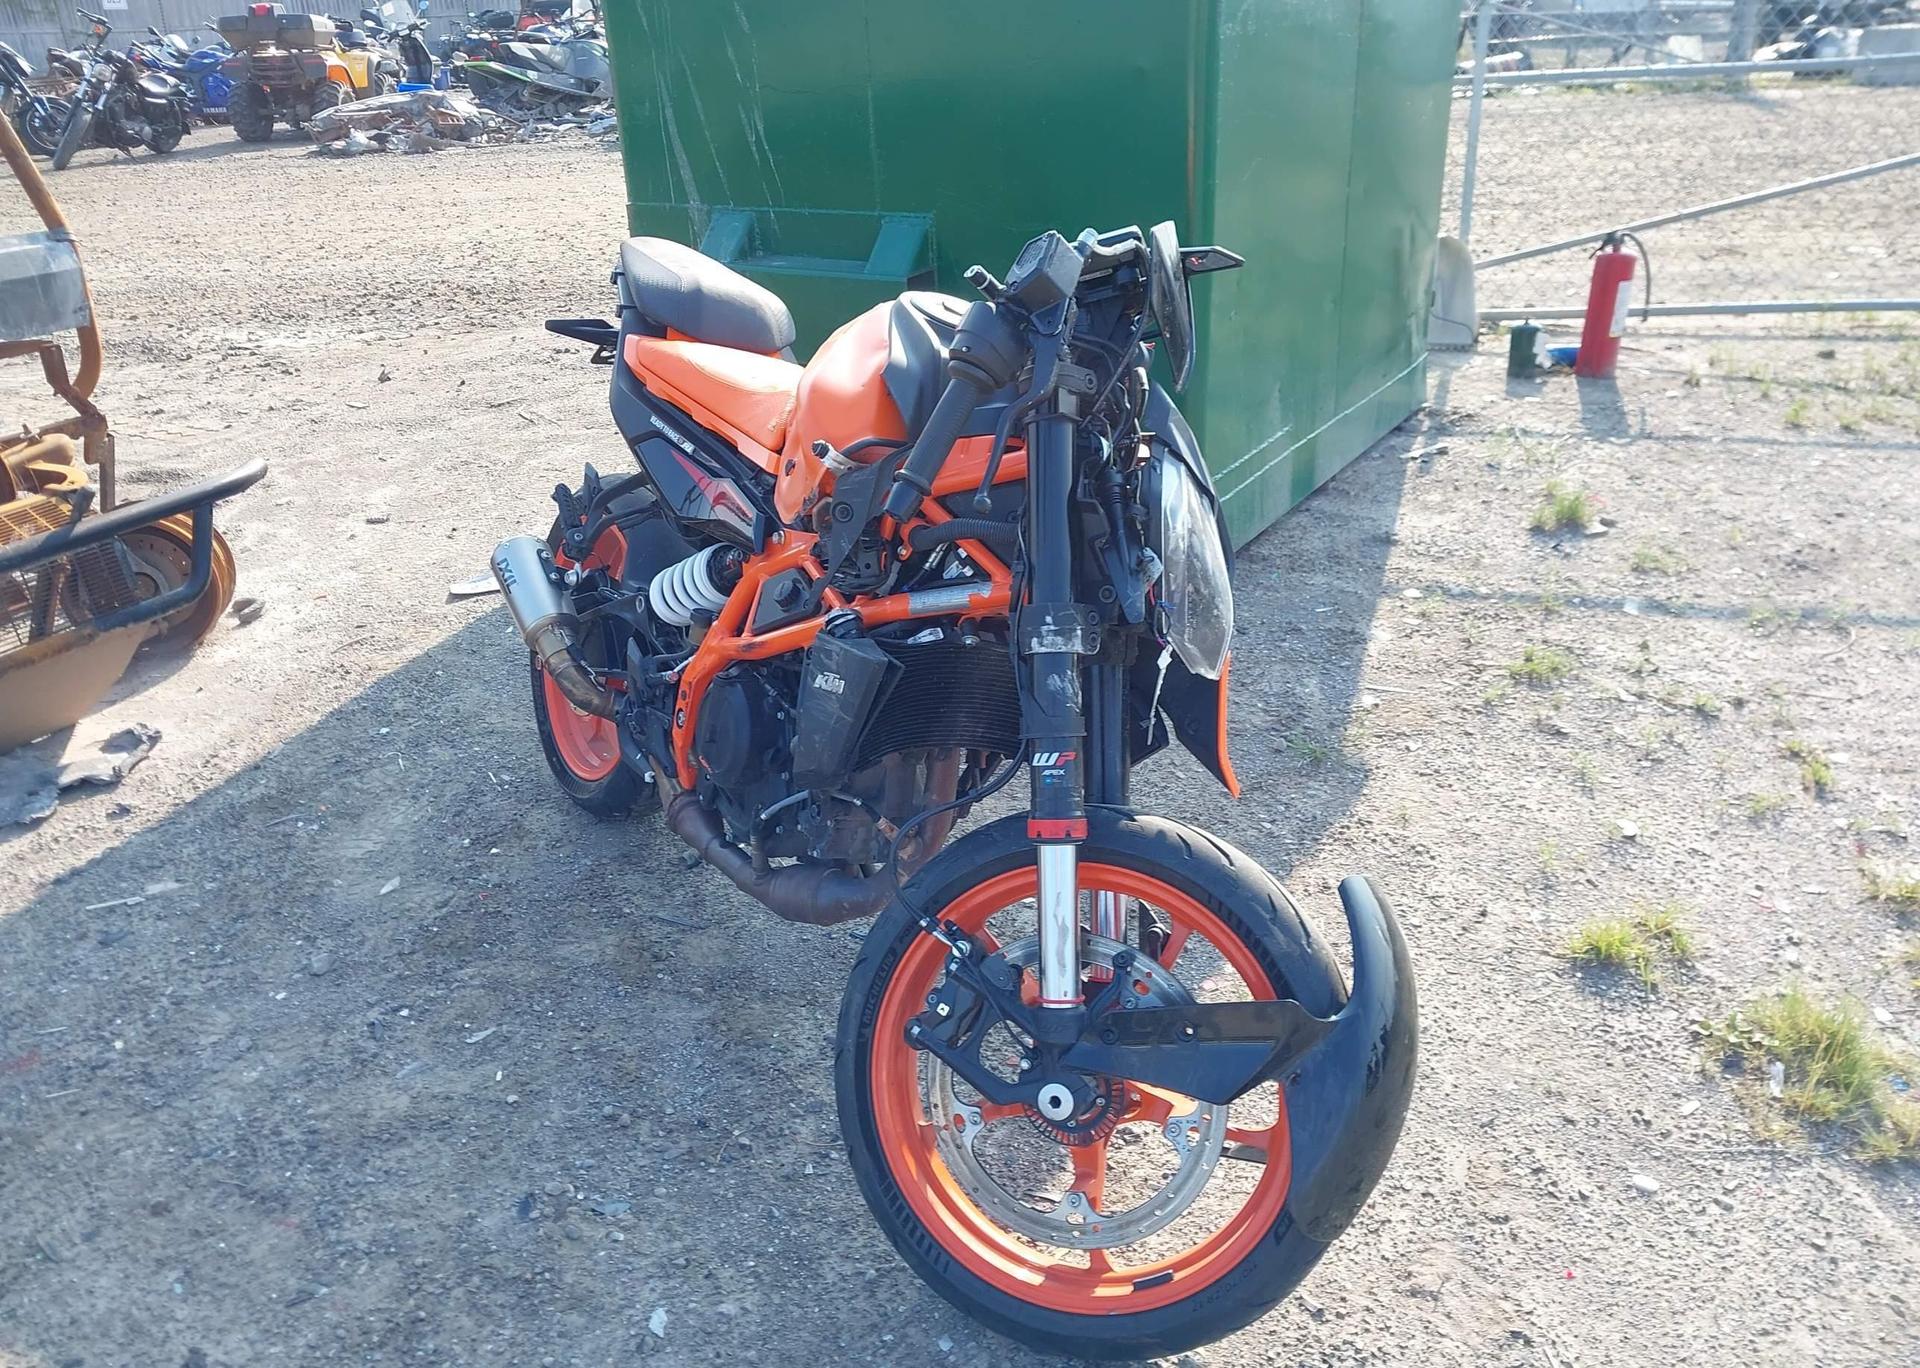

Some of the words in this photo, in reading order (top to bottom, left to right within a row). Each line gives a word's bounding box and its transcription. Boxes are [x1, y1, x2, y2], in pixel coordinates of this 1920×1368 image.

[813, 671, 846, 695] KTM
[1032, 751, 1077, 766] WP
[861, 951, 897, 1026] MICHELIN
